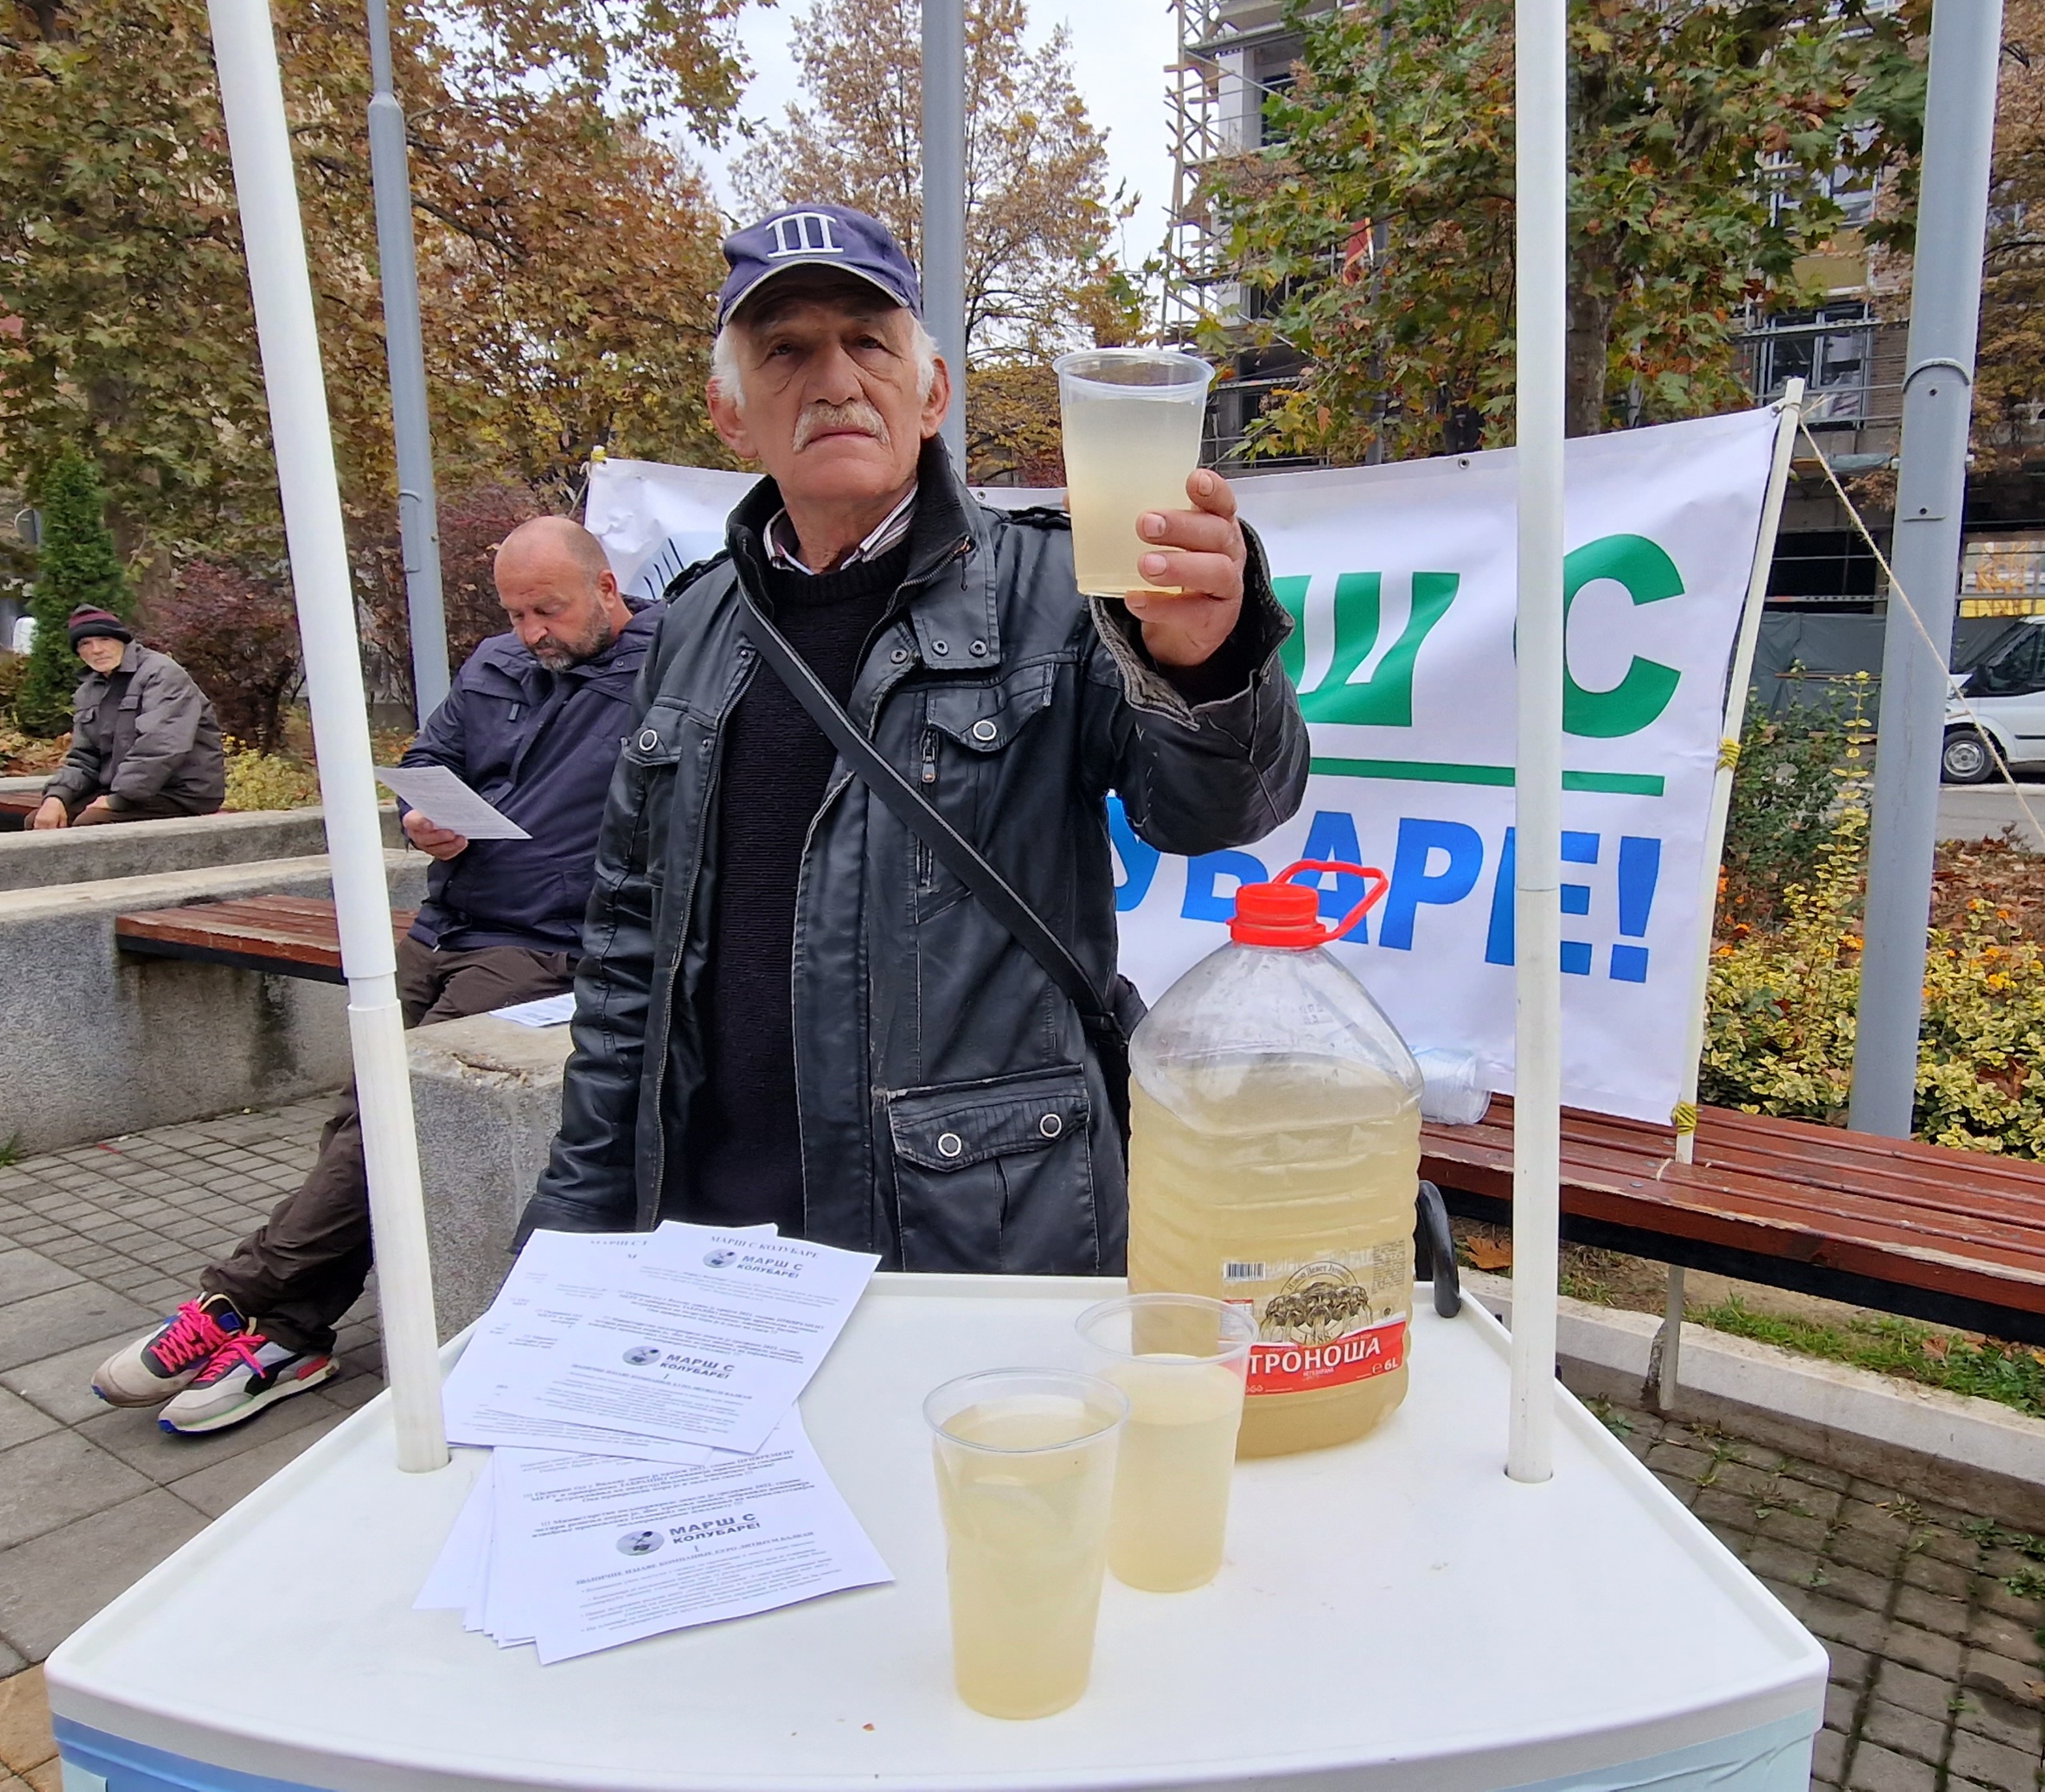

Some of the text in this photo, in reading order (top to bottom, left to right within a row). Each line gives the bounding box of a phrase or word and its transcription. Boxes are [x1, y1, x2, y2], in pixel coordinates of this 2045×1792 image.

[1514, 533, 1686, 739] С
[736, 1263, 799, 1279] КОЛУБАРЕ!
[741, 1254, 804, 1272] МАРШ С
[666, 1354, 735, 1373] МАРШ С
[1249, 1338, 1381, 1374] ТРОНОША
[1384, 1358, 1399, 1371] 6L
[659, 1362, 730, 1380] КОЛУБАРЕ!
[668, 1513, 756, 1536] МАРШ С
[673, 1522, 761, 1544] КОЛУБАРЕ!
